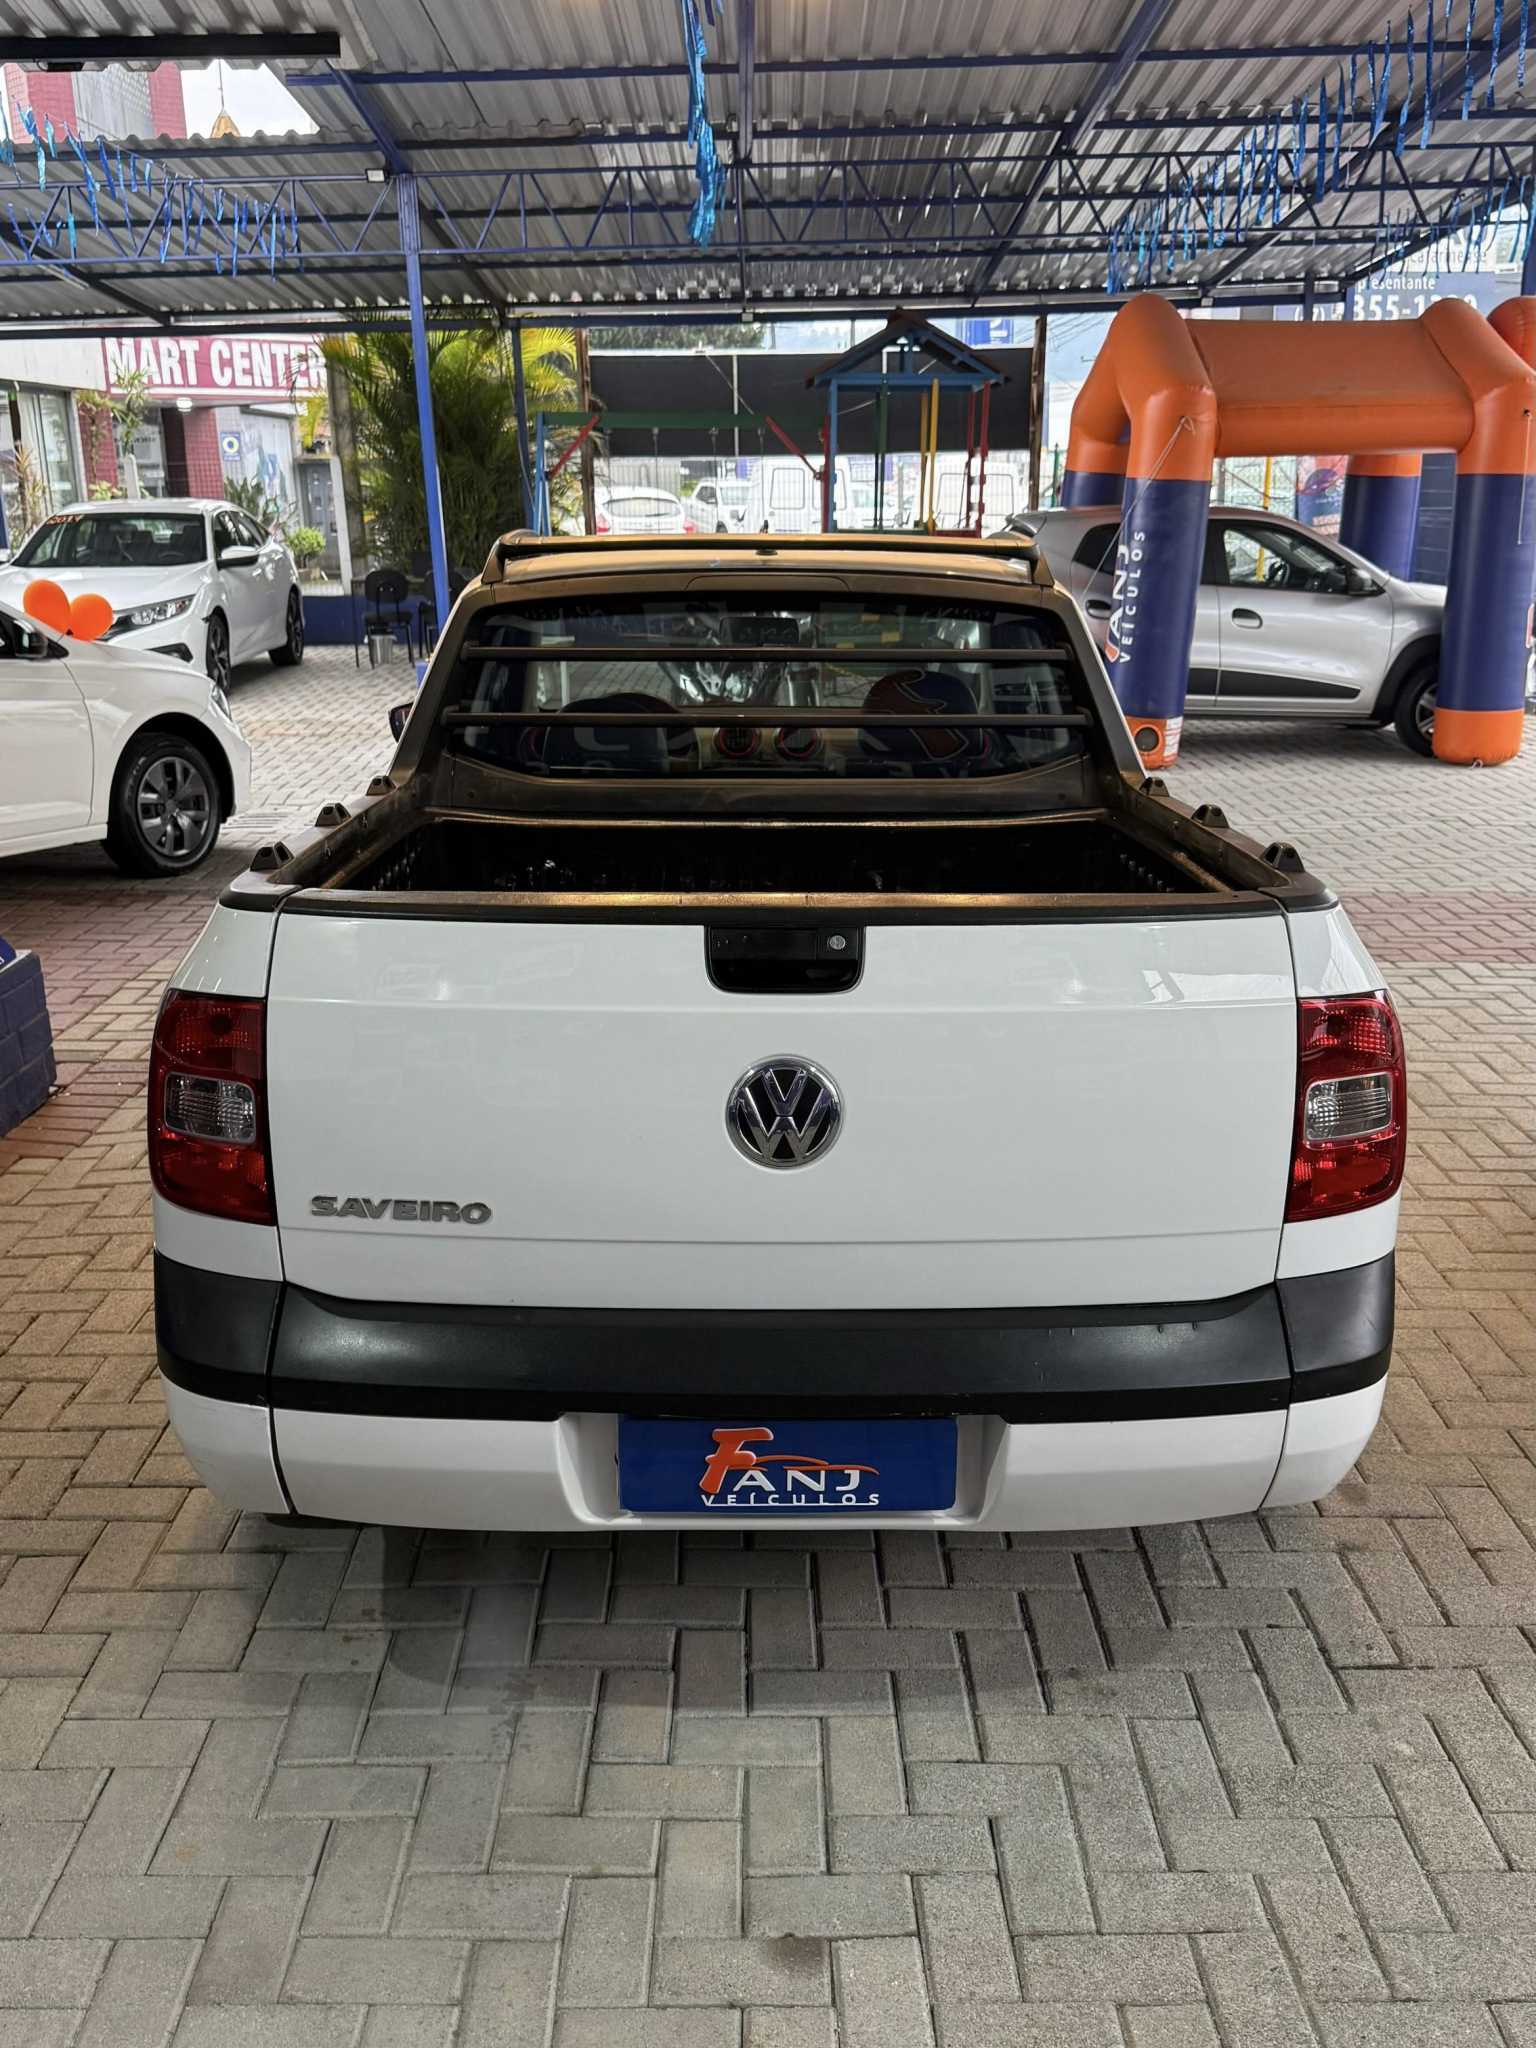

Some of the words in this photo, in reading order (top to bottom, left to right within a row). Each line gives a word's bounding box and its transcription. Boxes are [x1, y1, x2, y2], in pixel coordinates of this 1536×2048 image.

[105, 337, 199, 386] MART
[210, 339, 329, 388] CENTER
[732, 1060, 838, 1165] VW
[311, 1195, 492, 1225] SAVEIRO
[699, 1427, 862, 1495] FANJ
